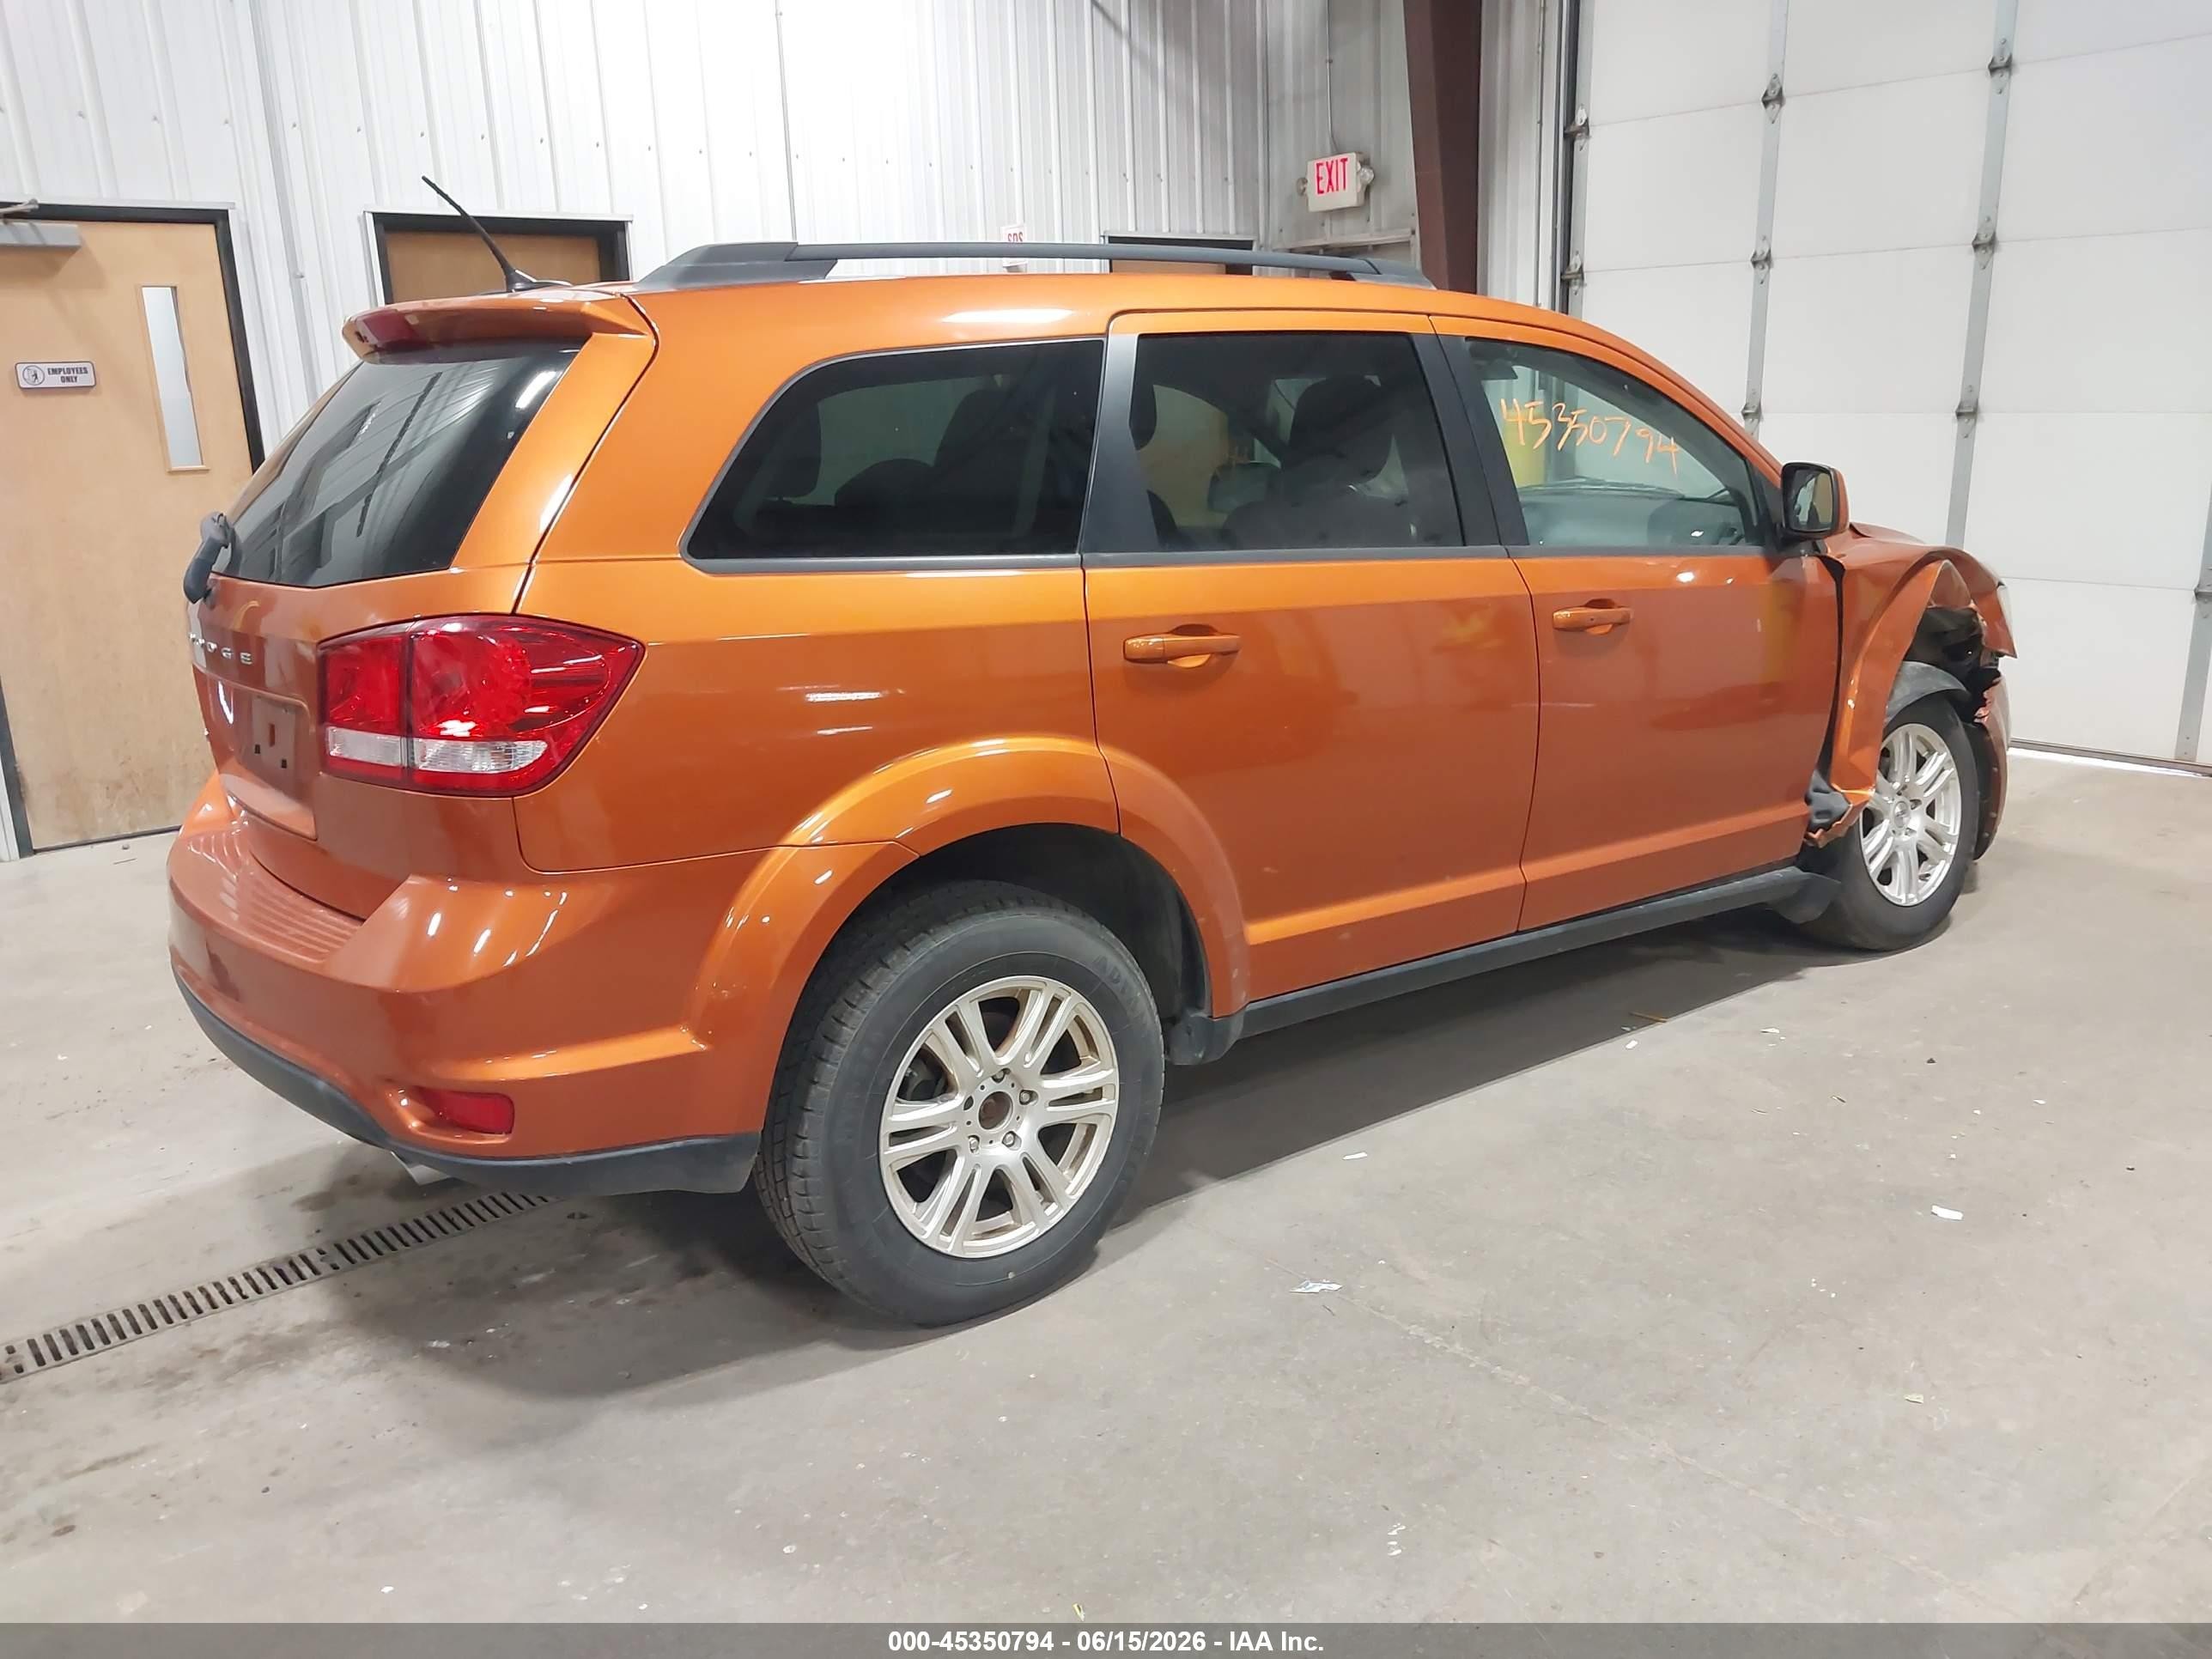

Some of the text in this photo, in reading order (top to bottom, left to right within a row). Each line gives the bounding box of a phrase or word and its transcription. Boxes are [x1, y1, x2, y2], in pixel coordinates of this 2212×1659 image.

[1316, 157, 1348, 195] EXIT
[47, 366, 88, 375] EMPLOYEES
[60, 374, 78, 383] ONLY
[1499, 398, 1680, 476] 45350794
